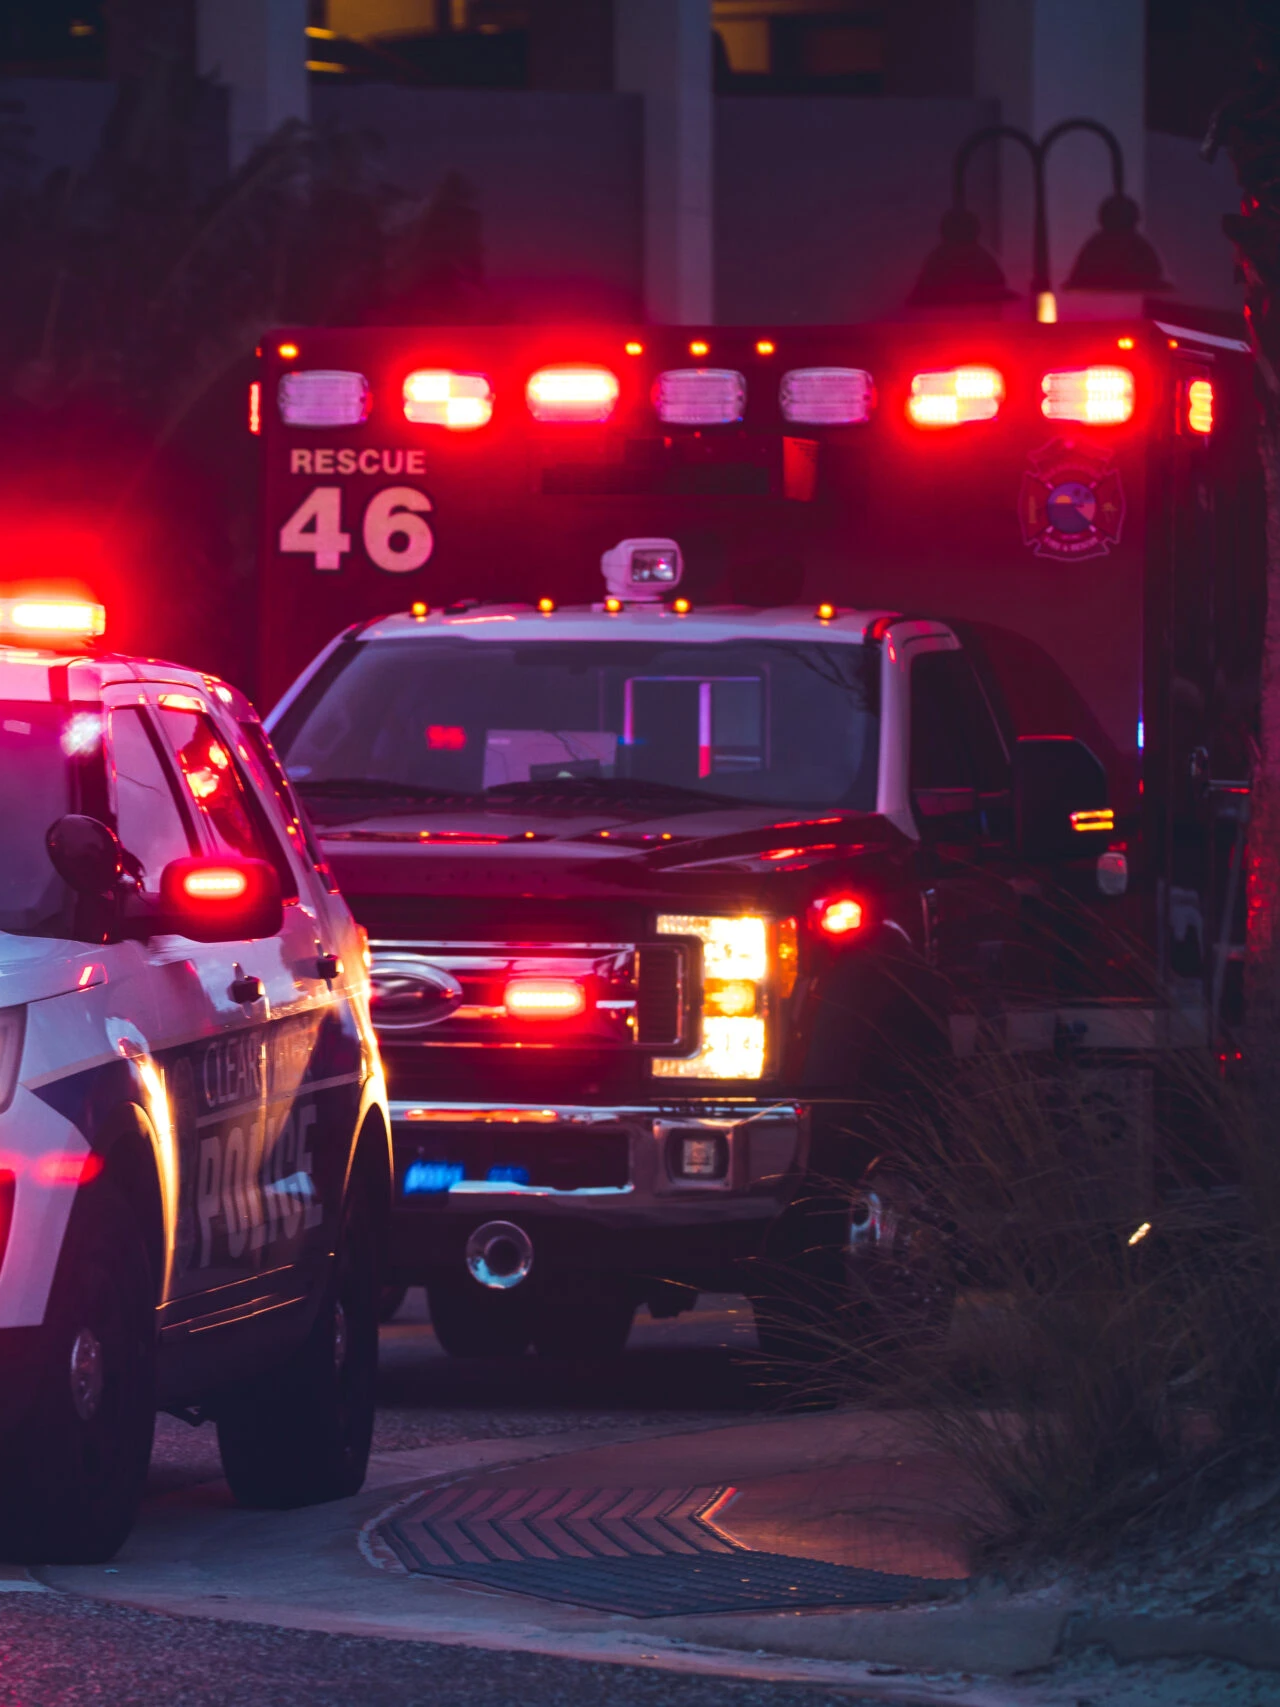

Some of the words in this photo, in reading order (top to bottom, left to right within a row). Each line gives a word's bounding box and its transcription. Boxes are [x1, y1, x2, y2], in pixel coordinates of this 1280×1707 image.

[290, 448, 426, 475] RESCUE
[278, 486, 434, 573] 46
[198, 1104, 324, 1269] POLICE
